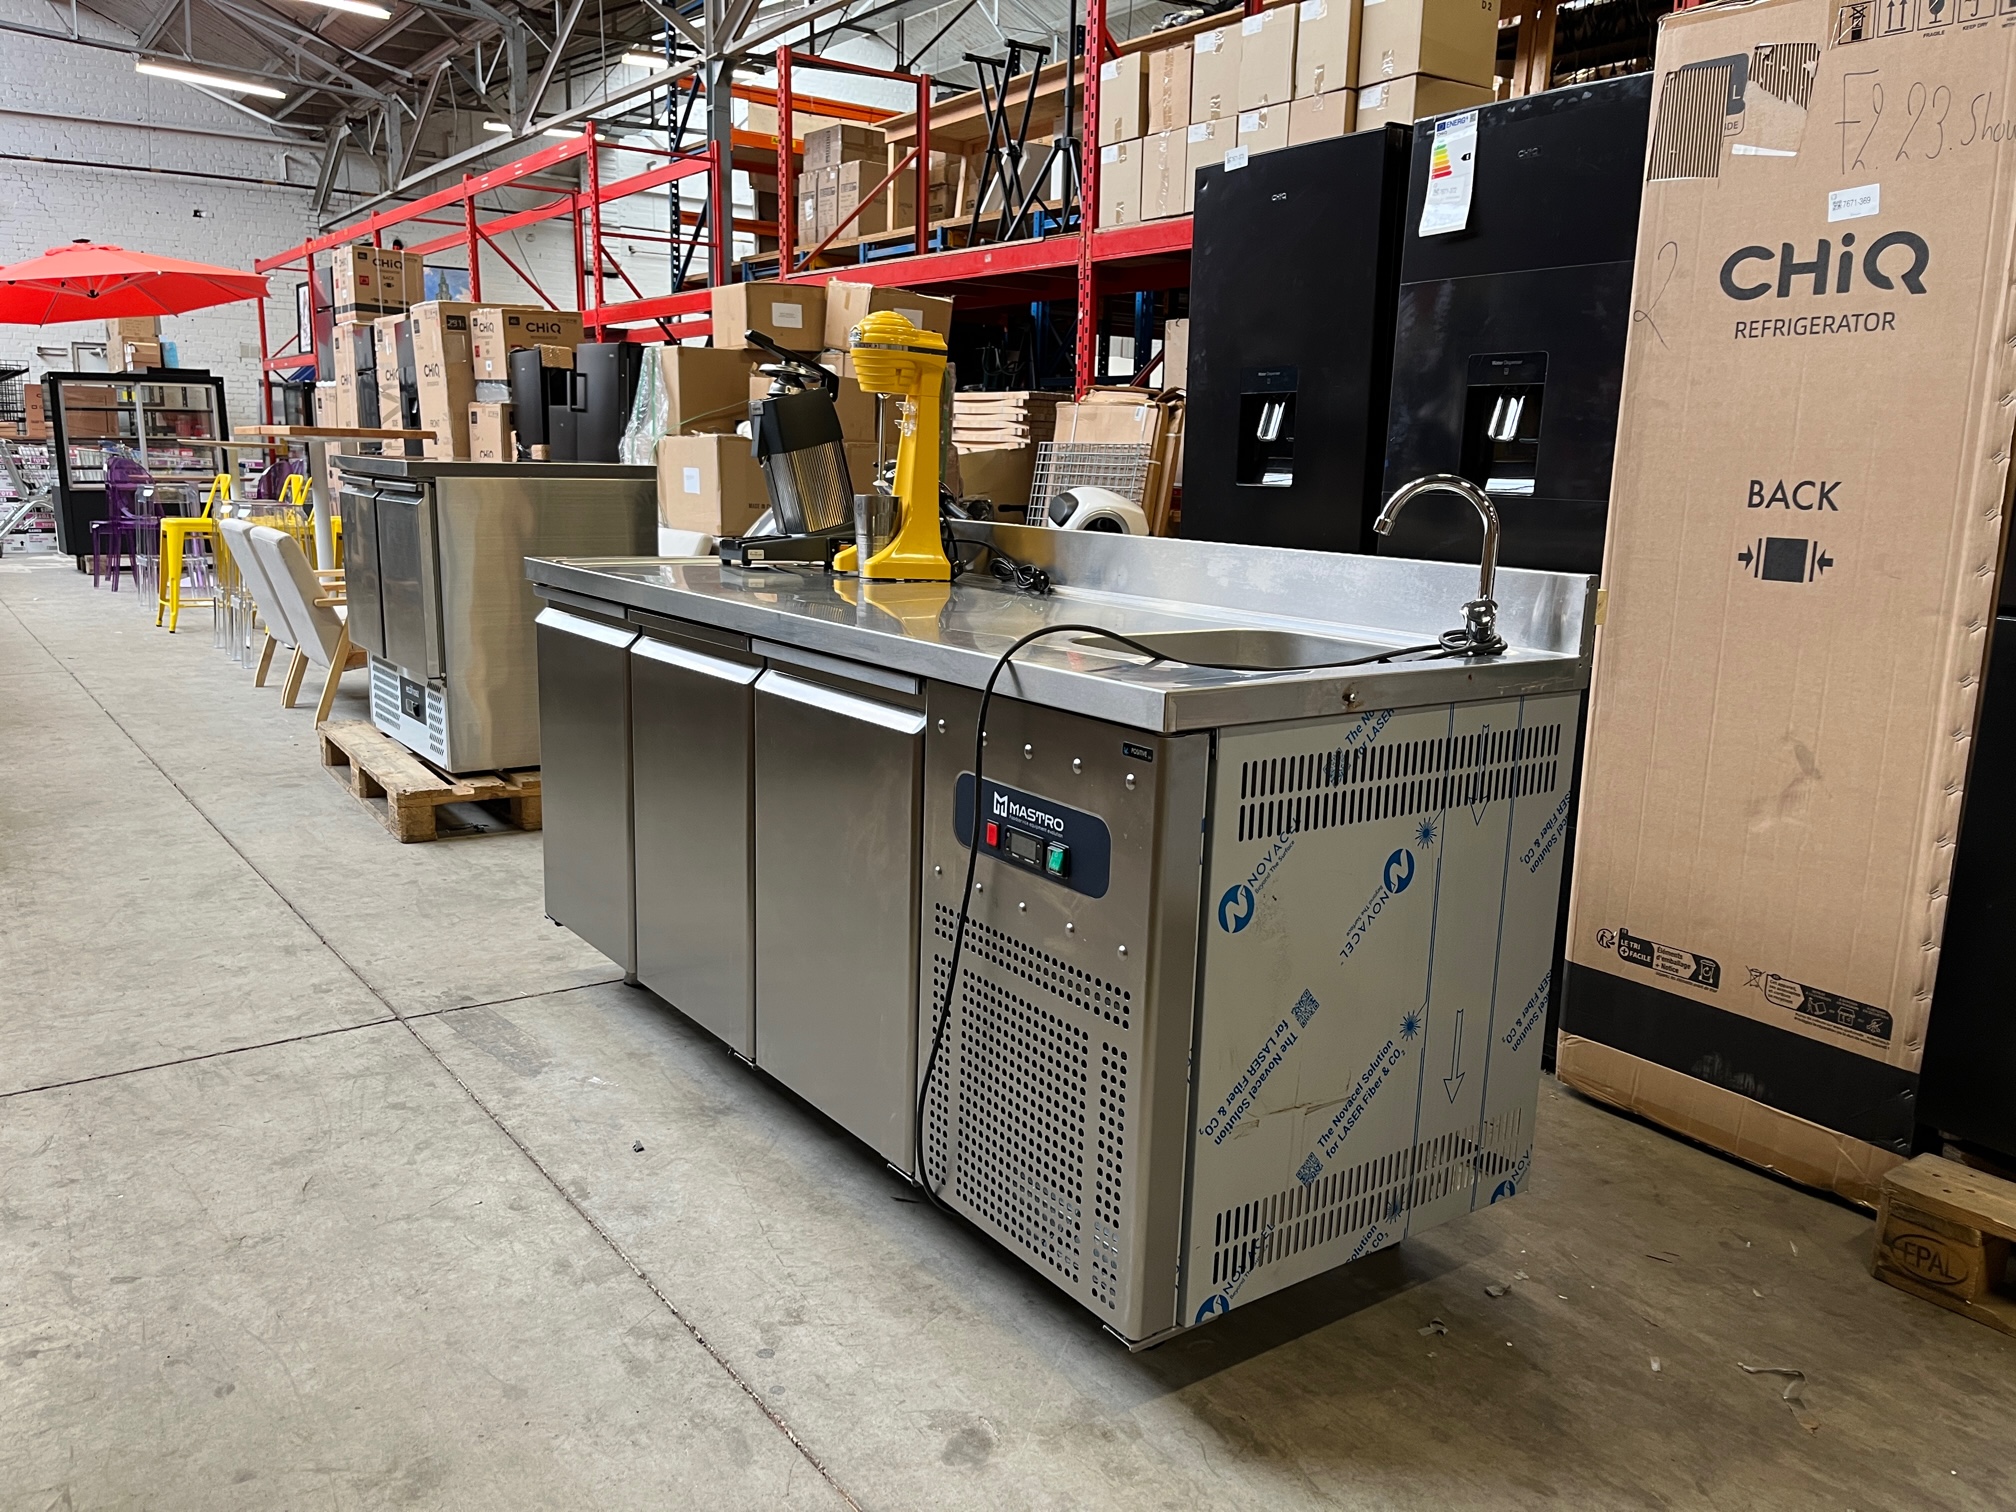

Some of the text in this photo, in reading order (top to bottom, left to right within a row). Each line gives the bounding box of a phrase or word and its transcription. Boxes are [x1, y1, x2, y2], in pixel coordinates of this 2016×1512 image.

[1922, 30, 1946, 39] FRAGILE
[1977, 21, 1989, 29] DRY
[525, 321, 562, 335] CHiQ
[1734, 311, 1896, 340] REFRIGERATOR
[1747, 479, 1842, 511] BACK
[1345, 724, 1363, 745] The
[1009, 801, 1064, 832] MASTRO
[1540, 812, 1559, 840] Fiber
[1529, 833, 1558, 874] Solution
[1339, 890, 1390, 958] NOVACEL
[1620, 938, 1641, 950] LE TRI
[1629, 950, 1652, 963] FACILE
[1655, 955, 1692, 970] d'emballage
[1660, 962, 1679, 974] Notice
[1521, 992, 1540, 1019] Fiber
[1274, 1019, 1289, 1038] for
[1511, 1011, 1539, 1052] Solution
[1246, 1036, 1277, 1077] LASER
[1214, 1032, 1299, 1146] The Novacel Solution
[1225, 1075, 1250, 1106] Fiber
[1317, 1039, 1394, 1148] The Novacel Solution
[1217, 1105, 1227, 1117] &
[1325, 1140, 1339, 1159] for
[1337, 1103, 1365, 1142] LASER
[1362, 1075, 1383, 1105] Fiber
[1381, 1066, 1390, 1077] &
[1350, 1224, 1378, 1261] olution
[1902, 1241, 1958, 1281] EPAL
